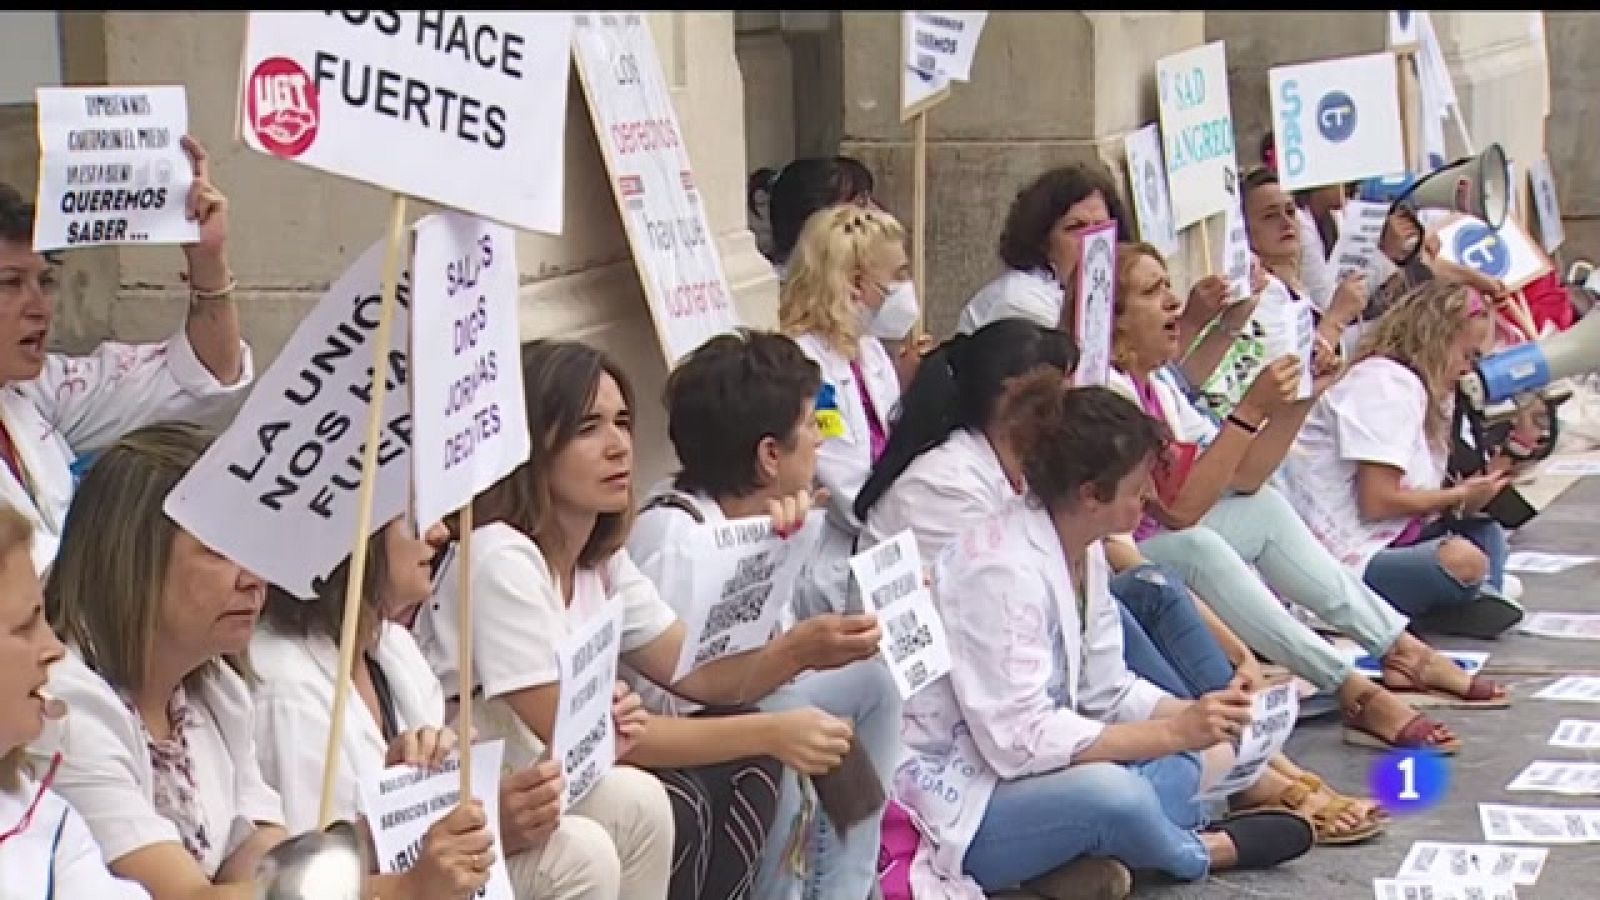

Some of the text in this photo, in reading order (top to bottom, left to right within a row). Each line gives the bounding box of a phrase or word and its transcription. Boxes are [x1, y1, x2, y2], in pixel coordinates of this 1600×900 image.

[416, 11, 526, 79] HACE
[255, 74, 308, 112] UGT
[314, 51, 507, 150] FUERTES
[61, 187, 168, 213] QUEREMOS
[227, 420, 291, 483] LA
[259, 409, 351, 511] NOS
